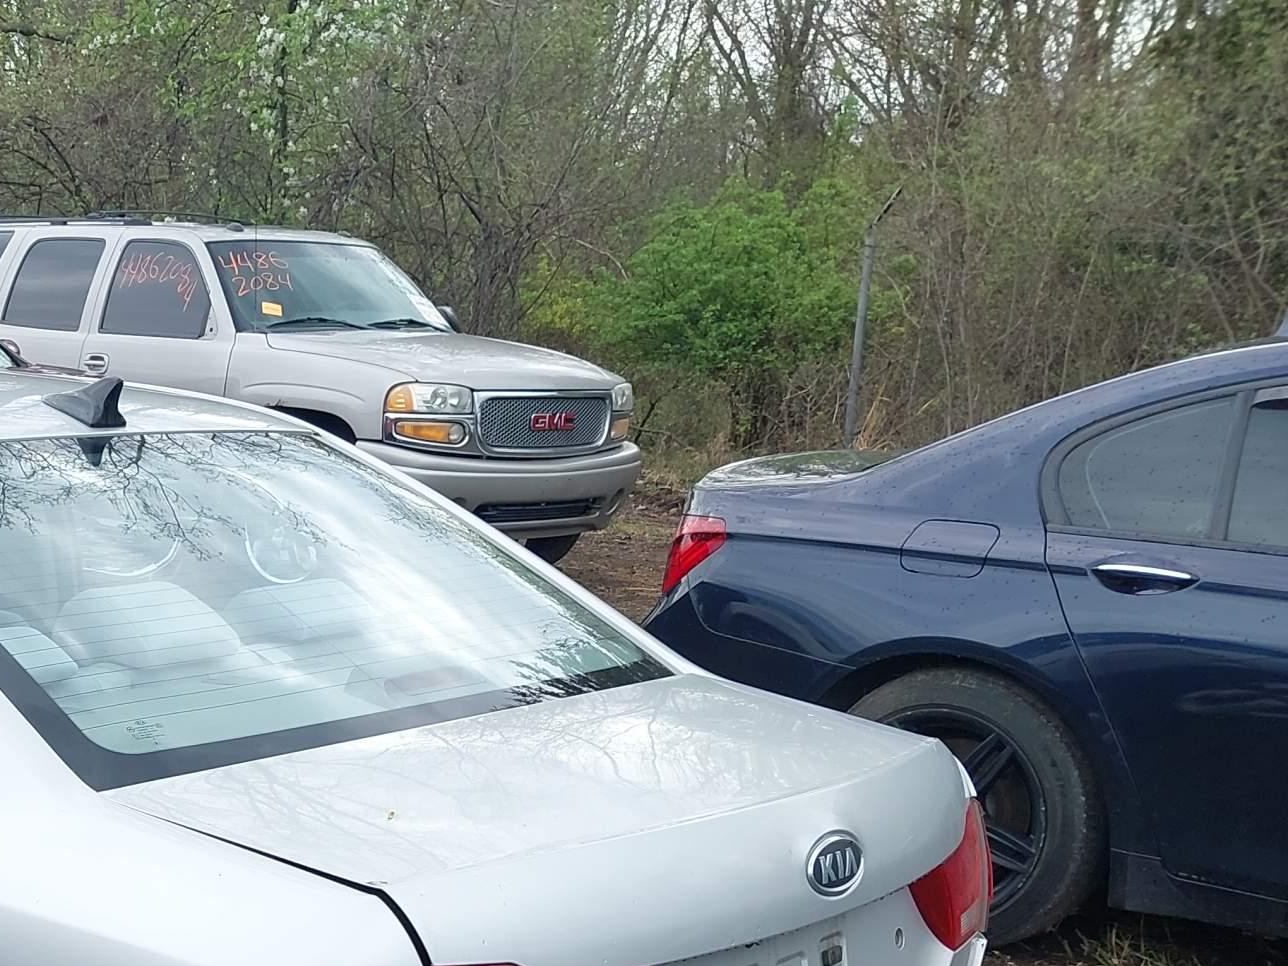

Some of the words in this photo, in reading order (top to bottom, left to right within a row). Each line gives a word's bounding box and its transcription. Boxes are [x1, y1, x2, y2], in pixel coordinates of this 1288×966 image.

[218, 251, 289, 275] 4486
[231, 272, 294, 297] 2084
[531, 412, 576, 431] GMC
[818, 846, 858, 885] KIA
